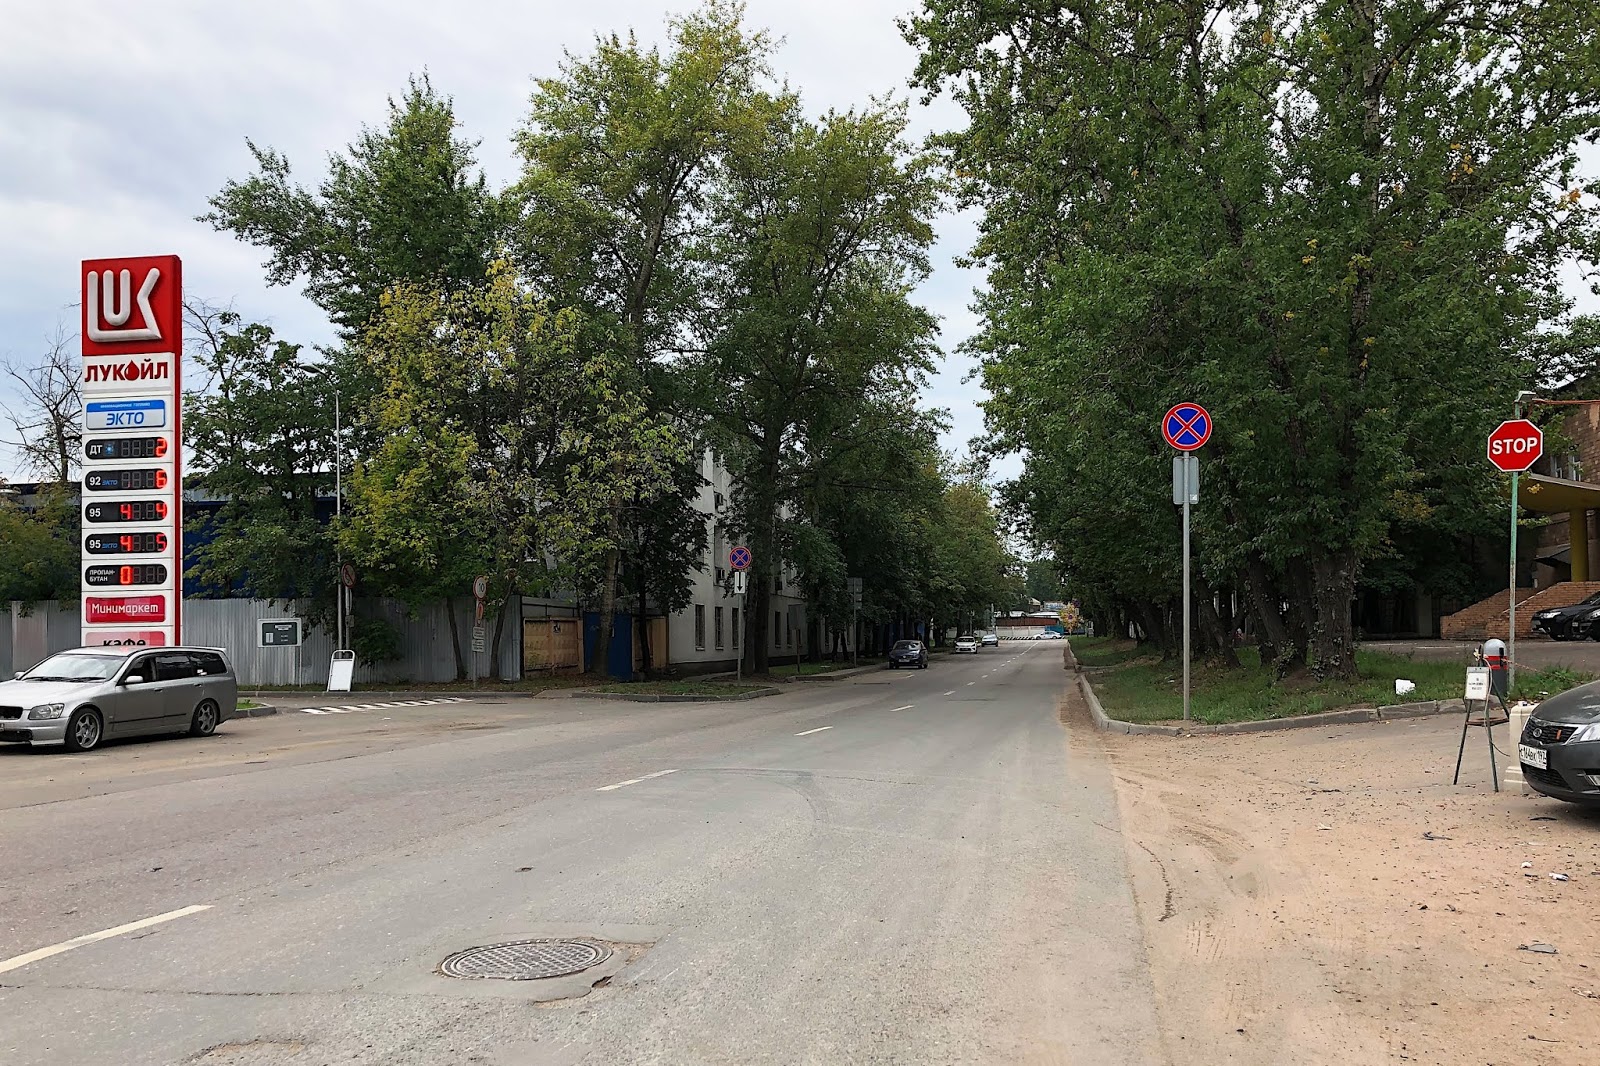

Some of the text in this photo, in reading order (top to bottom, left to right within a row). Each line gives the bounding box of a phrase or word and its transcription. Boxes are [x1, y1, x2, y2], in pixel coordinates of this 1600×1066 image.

[84, 358, 168, 382] ЛУКОЙЛ
[106, 412, 144, 425] ЭКТО
[89, 445, 103, 455] ДТ
[1492, 437, 1538, 455] STOP
[89, 476, 101, 486] 92
[89, 508, 101, 517] 95
[89, 540, 101, 549] 95
[92, 603, 159, 616] Минимаркет
